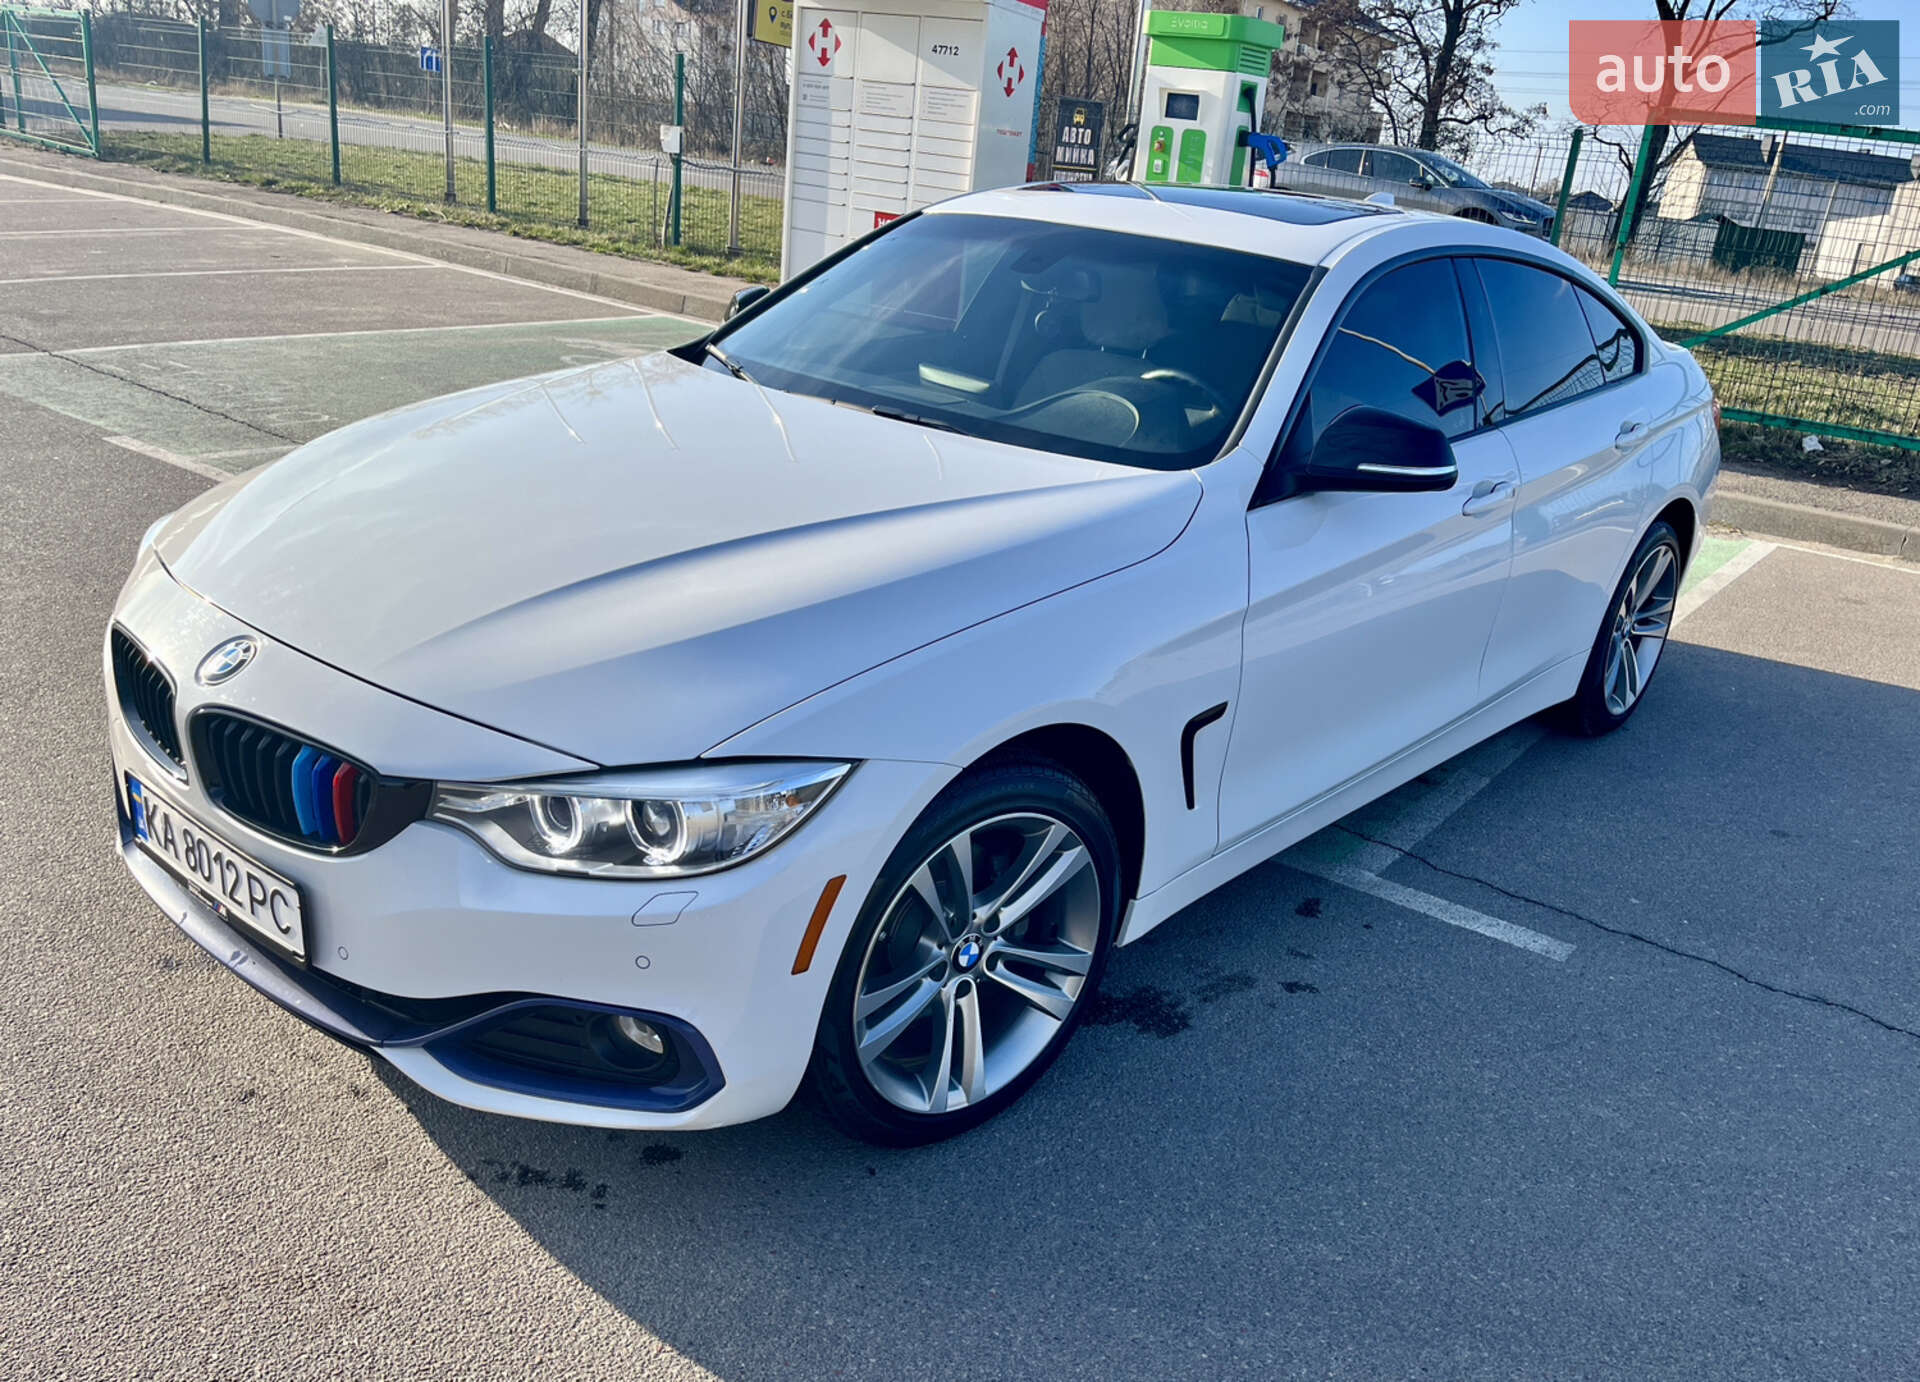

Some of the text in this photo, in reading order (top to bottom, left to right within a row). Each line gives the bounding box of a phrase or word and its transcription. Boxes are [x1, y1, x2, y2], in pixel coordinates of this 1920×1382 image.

[931, 44, 960, 56] 47712
[1062, 126, 1092, 145] АВТО
[183, 828, 243, 908] 8012
